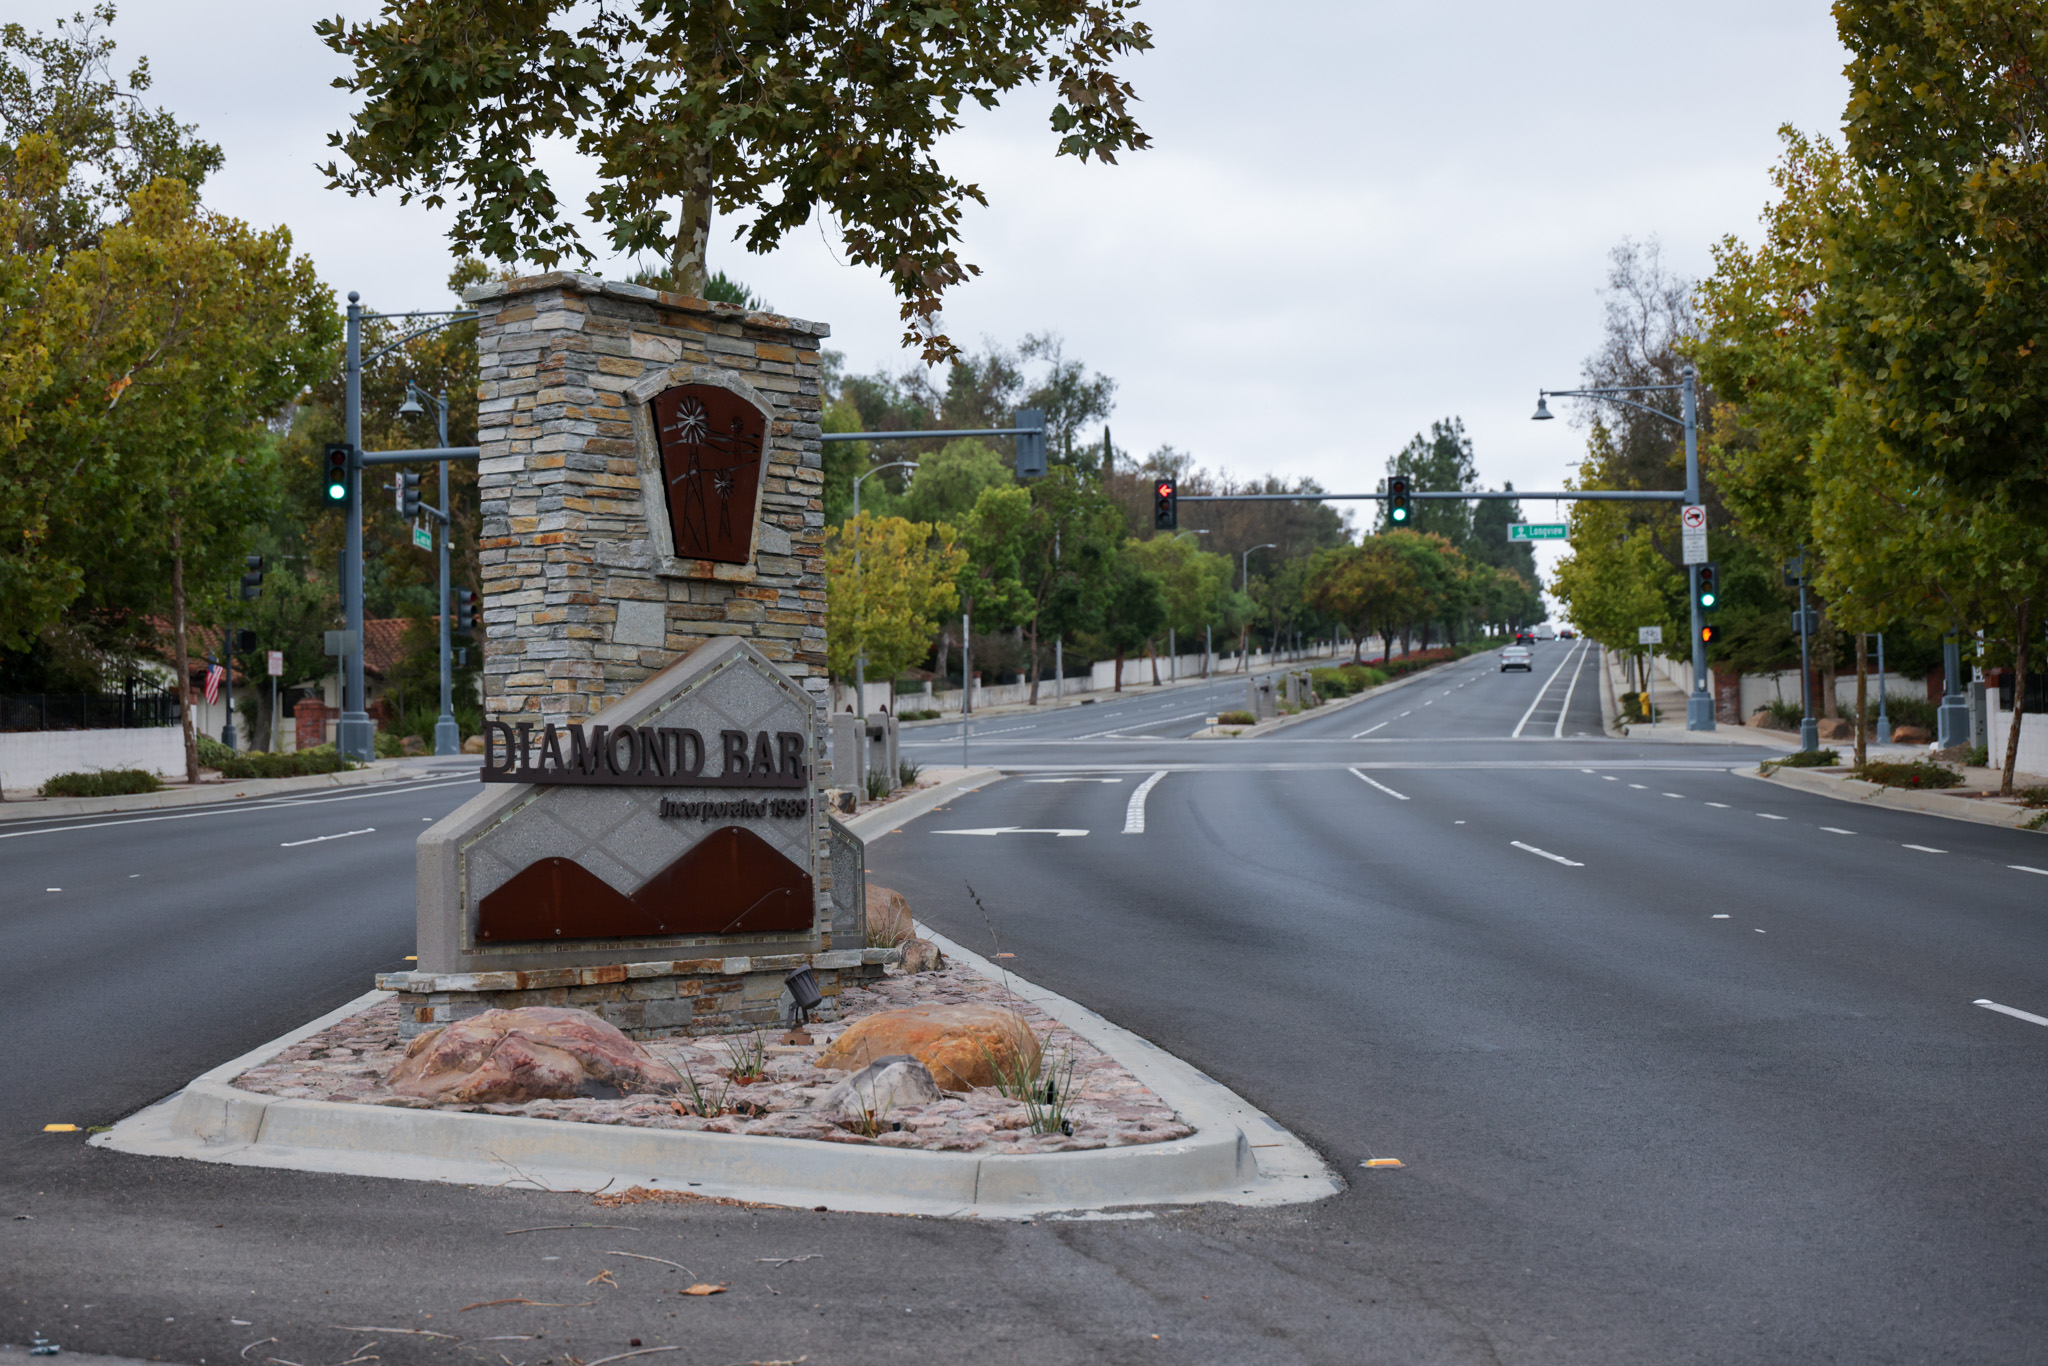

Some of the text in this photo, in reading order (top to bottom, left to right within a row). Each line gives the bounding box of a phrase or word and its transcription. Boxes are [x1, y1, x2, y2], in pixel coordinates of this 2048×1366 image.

[1529, 525, 1563, 538] Longview
[482, 720, 806, 781] DIAMOND BAR
[659, 797, 808, 823] Incorporated 1989
